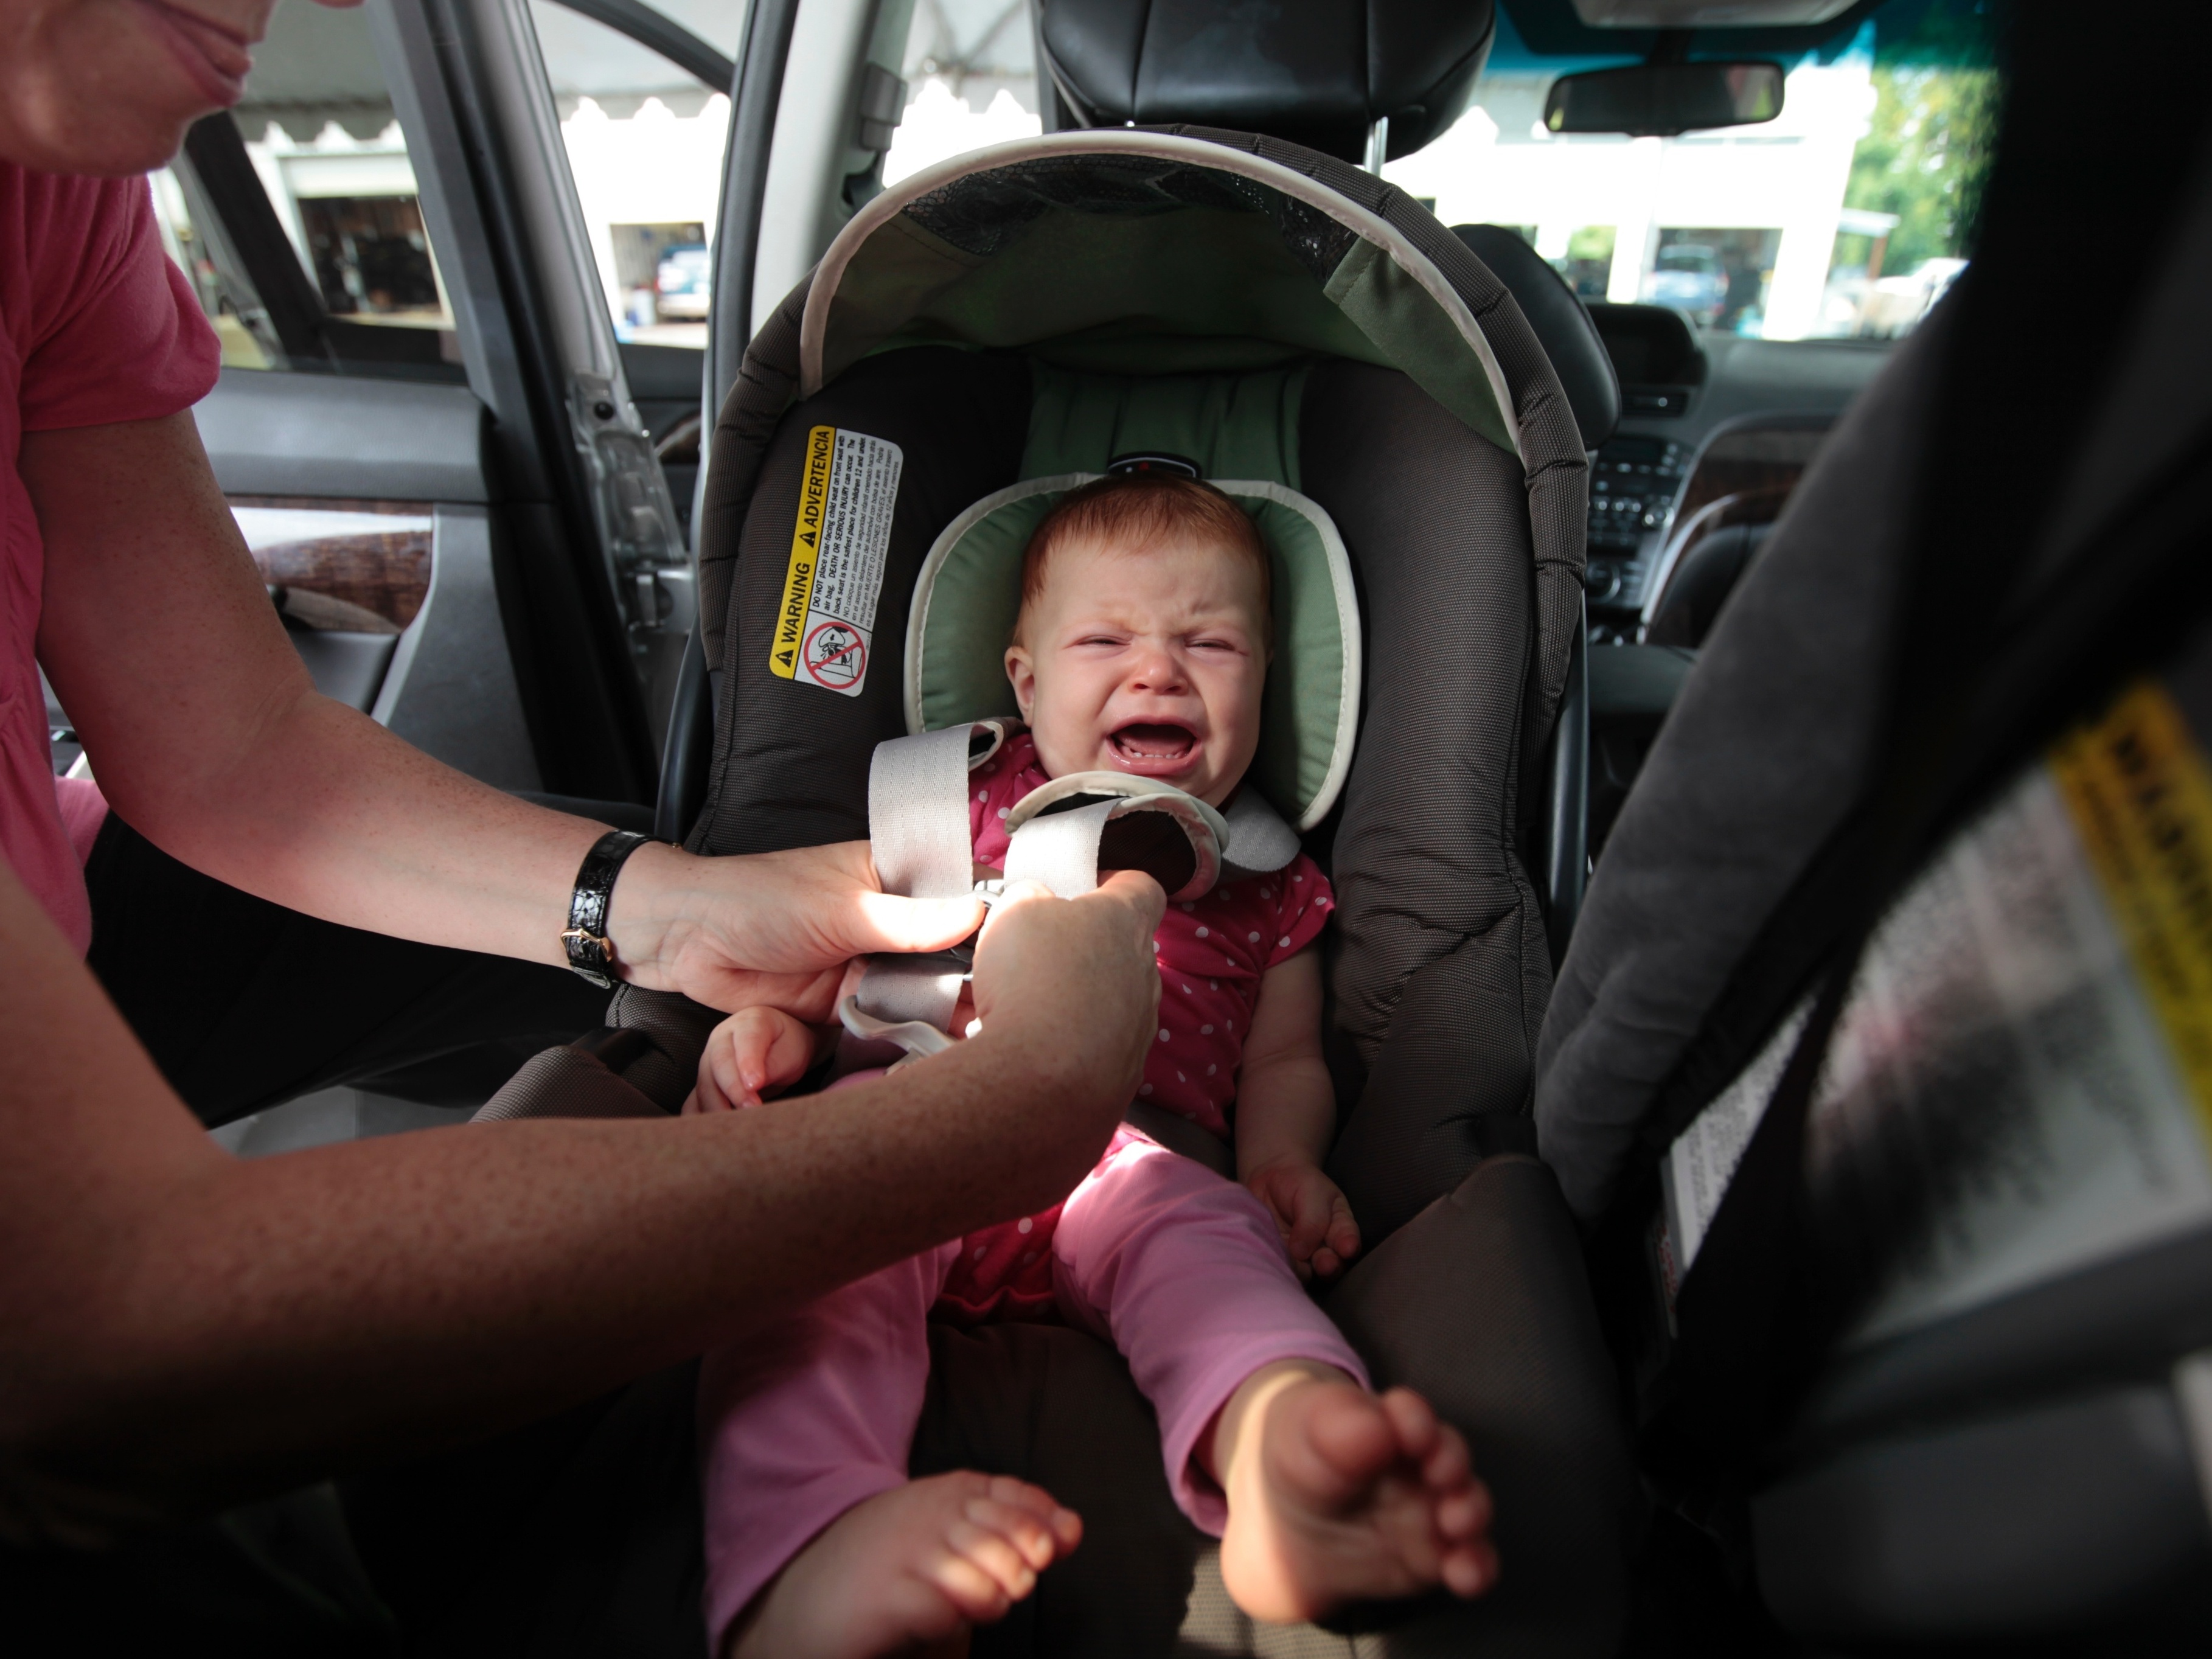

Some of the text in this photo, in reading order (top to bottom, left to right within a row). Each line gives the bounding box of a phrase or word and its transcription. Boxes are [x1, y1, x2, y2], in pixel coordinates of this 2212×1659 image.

[840, 486, 849, 509] INJURY
[781, 431, 830, 642] WARNING ADVERTENCIA
[812, 596, 821, 607] DO
[819, 559, 827, 579] place
[823, 520, 835, 557] rear-facing
[833, 462, 842, 476] front
[835, 511, 846, 541] SERIOUS
[858, 513, 866, 541] seguridad
[833, 597, 841, 614] back
[844, 536, 852, 558] safest
[852, 479, 860, 505] children
[833, 543, 840, 553] OR
[864, 563, 874, 591] MUERTE
[871, 524, 881, 556] LESIONES
[829, 555, 838, 578] DEATH
[858, 554, 868, 582] delantero
[846, 582, 855, 606] coloque
[843, 607, 850, 617] NO
